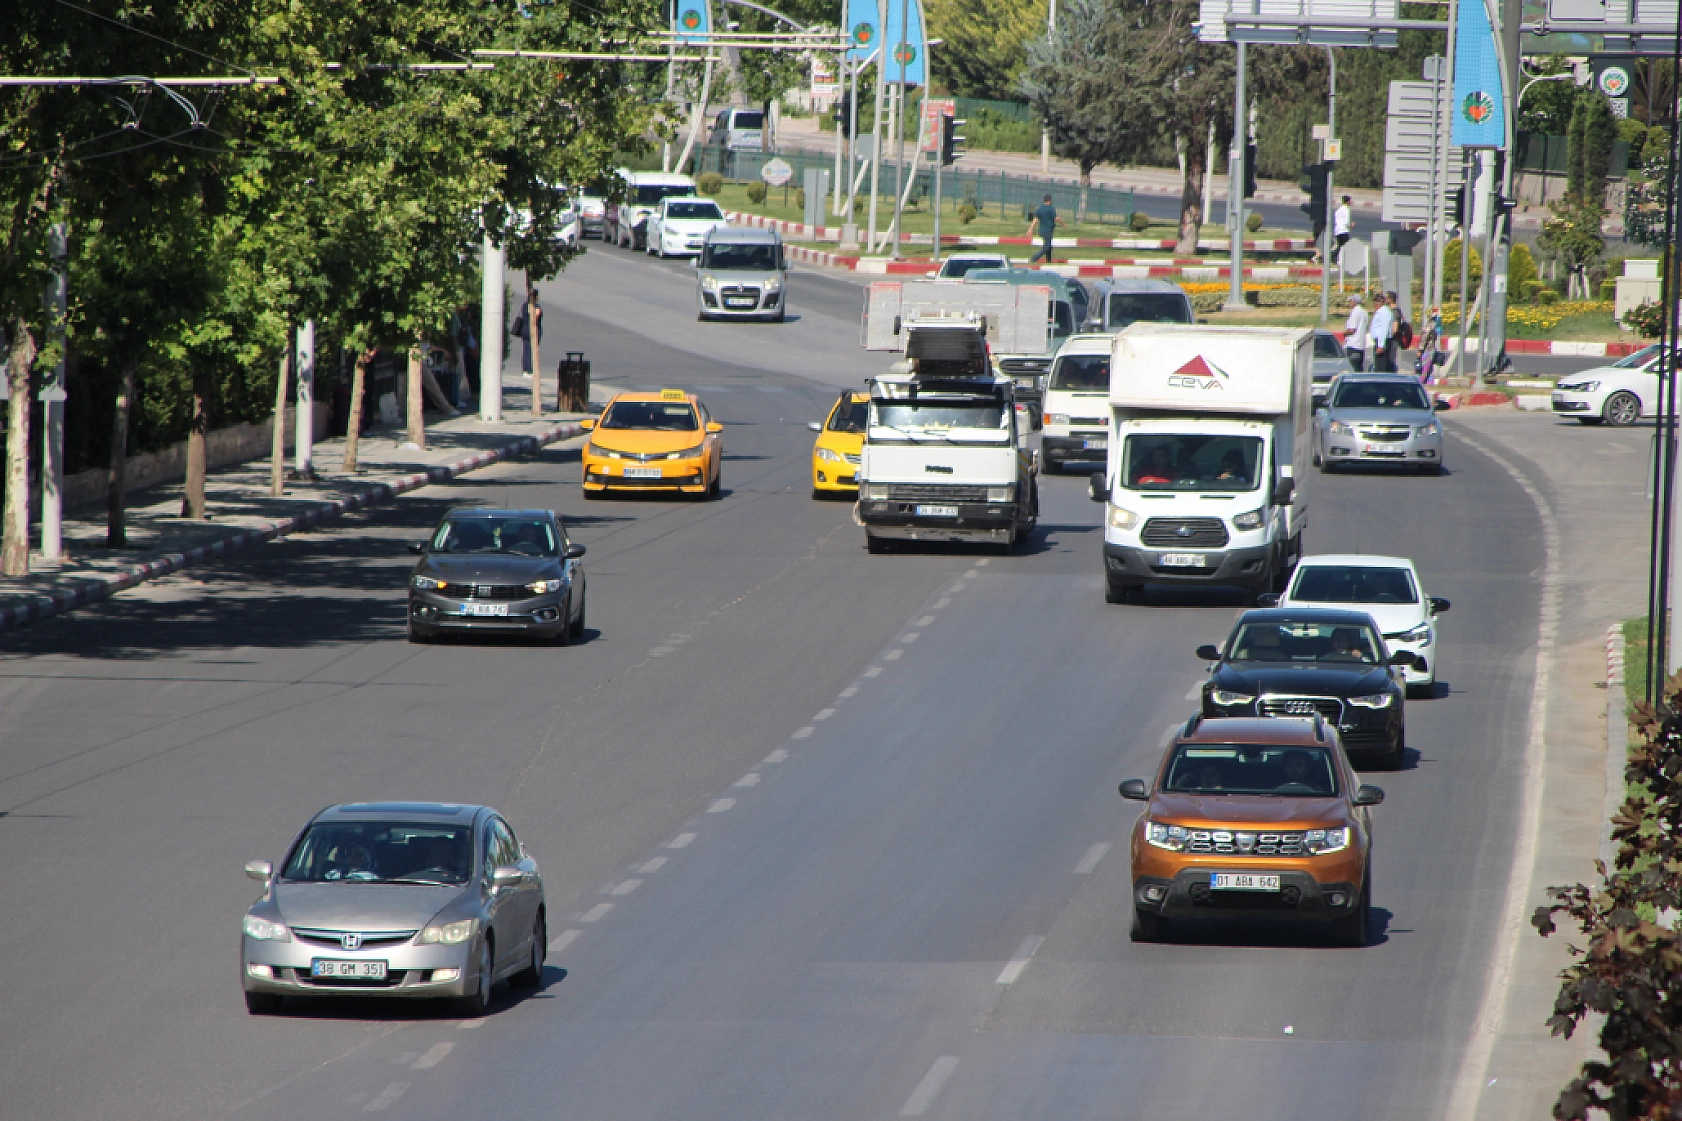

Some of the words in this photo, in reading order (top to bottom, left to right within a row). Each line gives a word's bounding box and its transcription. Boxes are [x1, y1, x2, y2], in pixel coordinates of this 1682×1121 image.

[1217, 875, 1229, 887] 01
[1260, 876, 1278, 888] 642
[319, 962, 334, 975] 38
[340, 963, 356, 975] GM
[363, 963, 384, 976] 351
